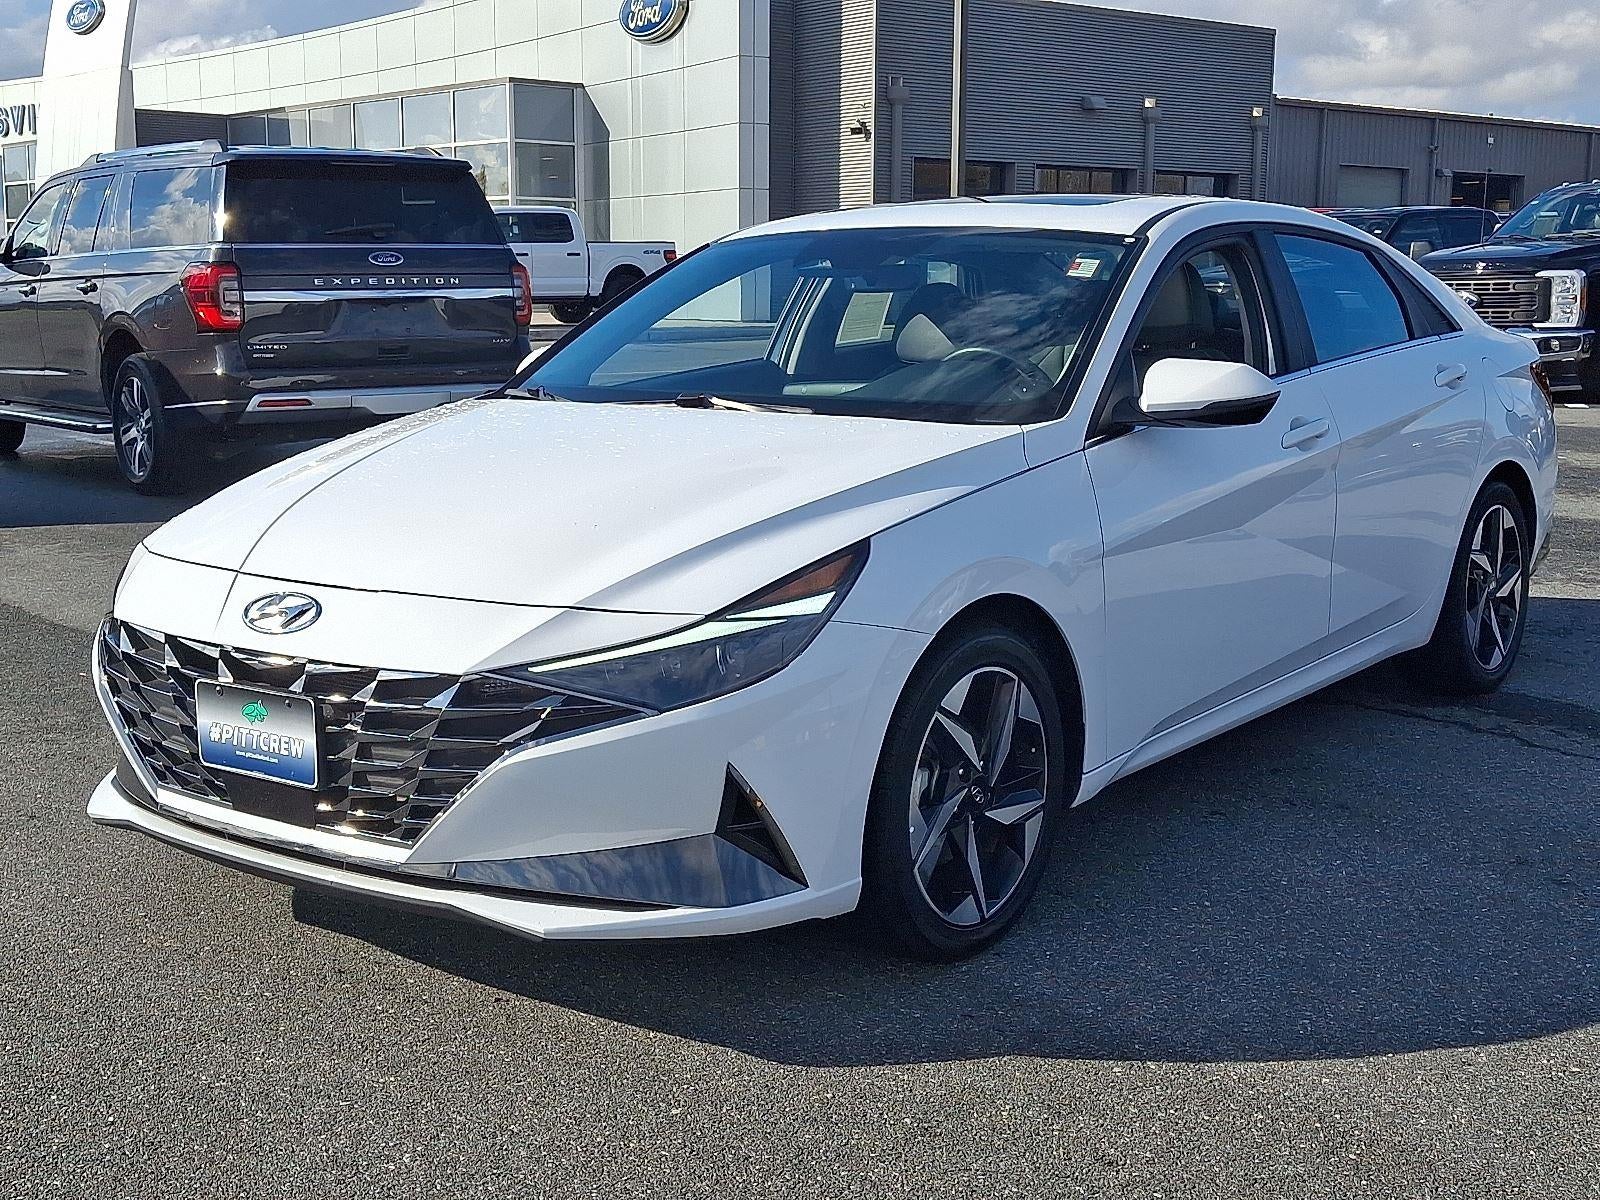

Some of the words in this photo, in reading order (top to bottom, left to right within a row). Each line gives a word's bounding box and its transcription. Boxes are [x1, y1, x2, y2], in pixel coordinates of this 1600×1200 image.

[628, 0, 662, 29] Ford
[313, 277, 460, 286] EXPEDITION
[208, 722, 306, 759] #PITTCREW
